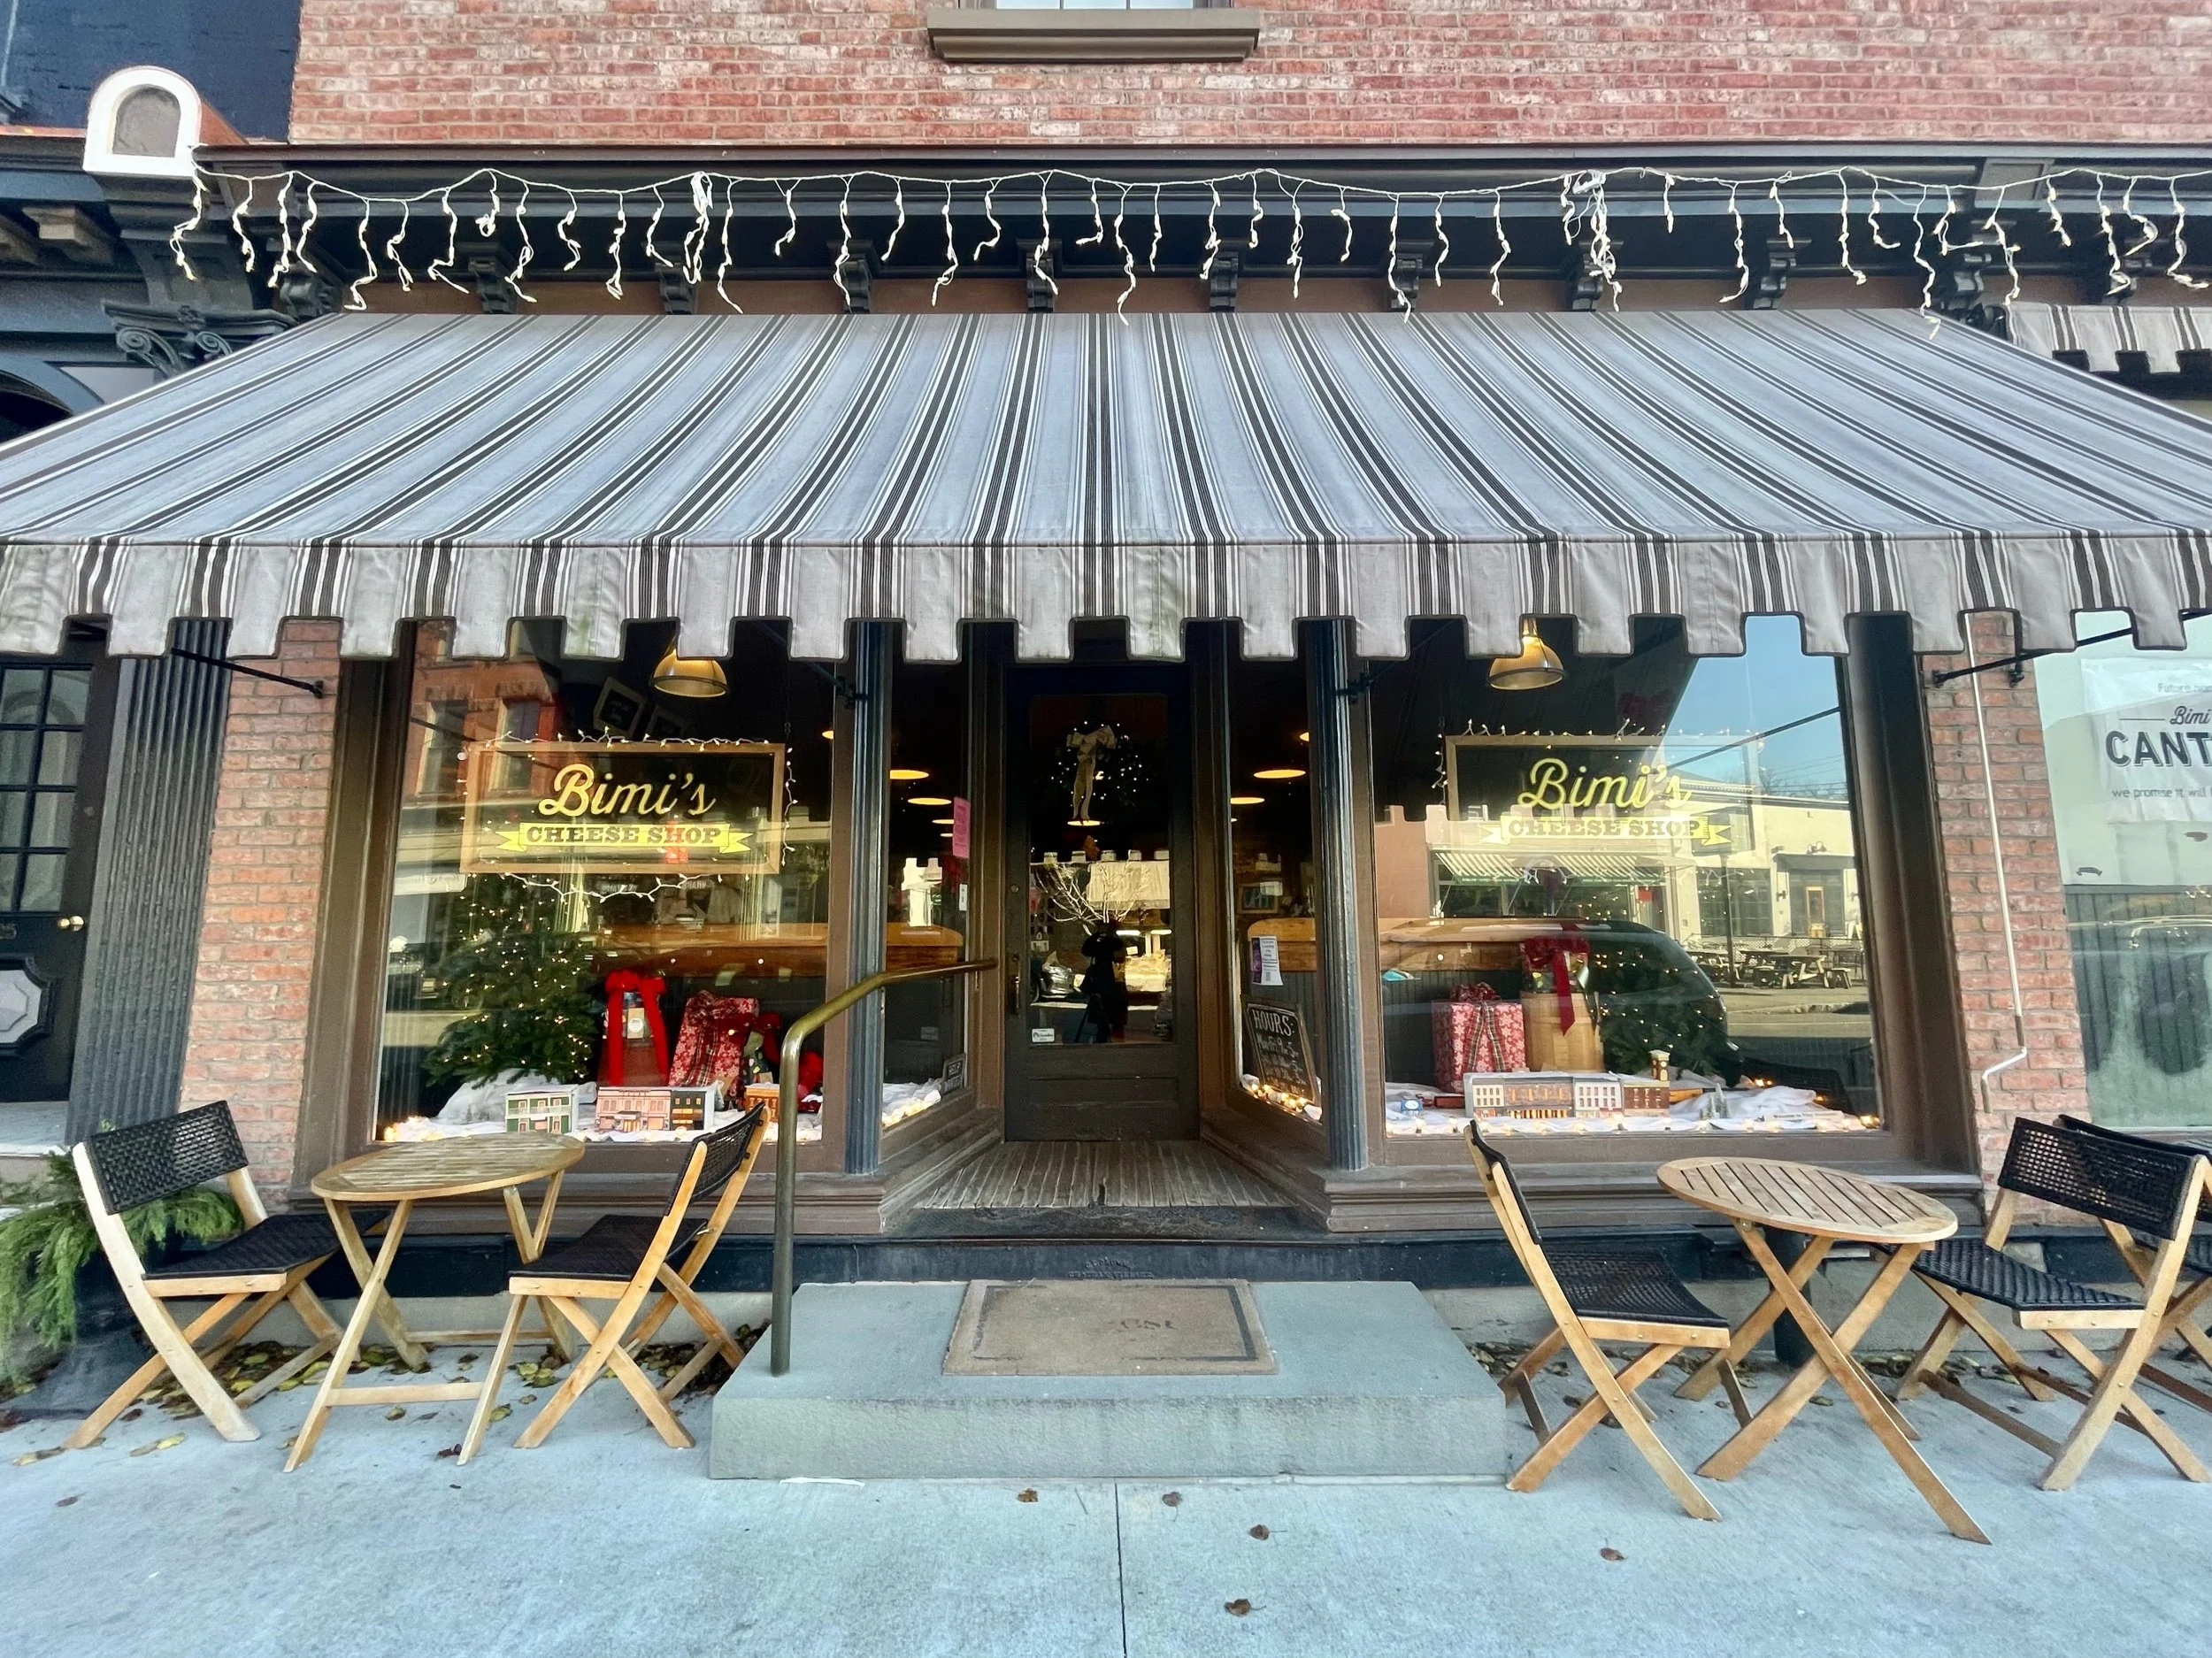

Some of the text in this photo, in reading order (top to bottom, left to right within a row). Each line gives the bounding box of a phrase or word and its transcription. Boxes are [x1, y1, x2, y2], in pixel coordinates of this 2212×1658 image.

[2106, 730, 2212, 767] CANT
[538, 763, 717, 817] Bimi's
[1517, 756, 1693, 810] Bimi's
[2112, 788, 2131, 798] we
[2133, 788, 2172, 800] promise
[526, 825, 721, 844] CHEESE SHOP
[1508, 819, 1701, 837] CHEESE SHOP
[1251, 1009, 1295, 1037] HOURS:
